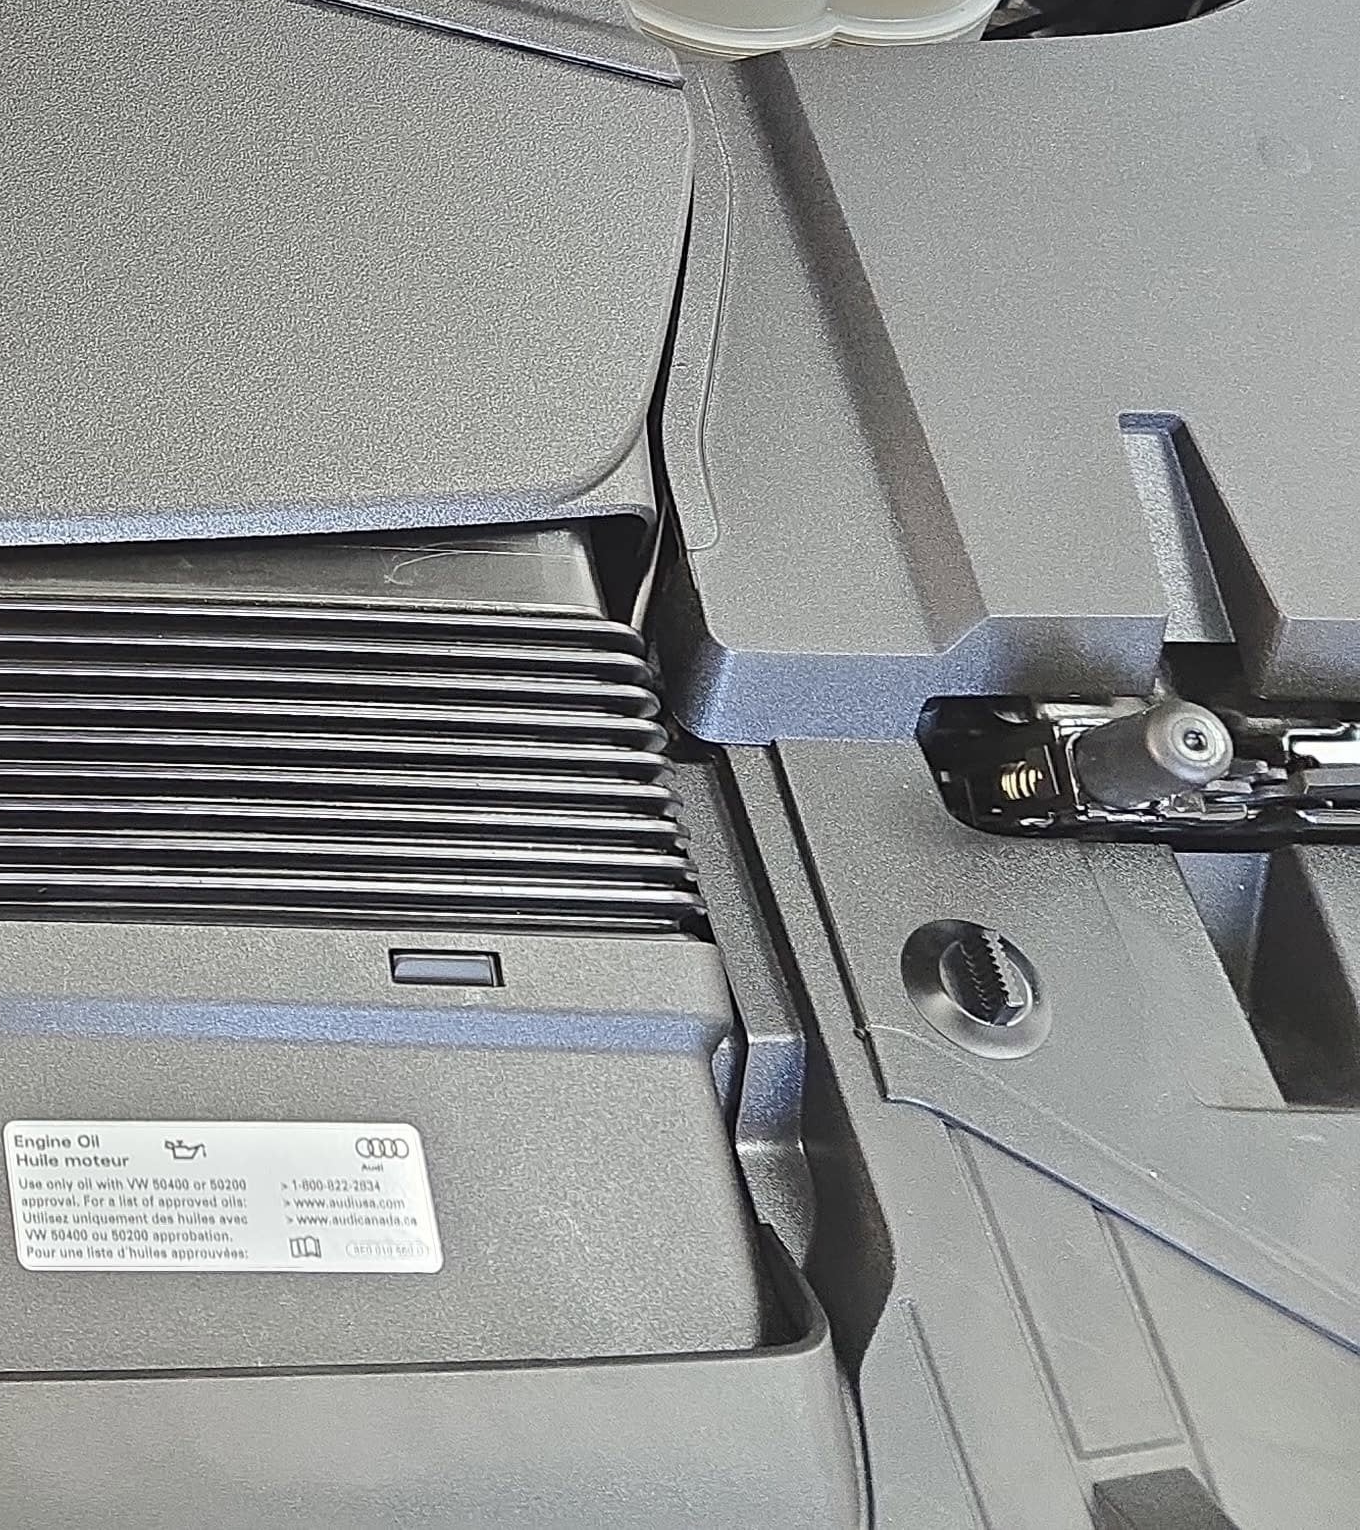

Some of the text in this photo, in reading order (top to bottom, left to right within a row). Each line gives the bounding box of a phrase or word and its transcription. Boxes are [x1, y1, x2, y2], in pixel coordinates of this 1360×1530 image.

[14, 1135, 100, 1150] Engine Oil
[16, 1154, 129, 1168] Huile moteur
[18, 1178, 247, 1192] Use only oil with VW 50400 or 50200
[21, 1195, 247, 1209] approval. For a list of approved oils:
[293, 1197, 405, 1209] www.audiusa.com
[22, 1212, 248, 1226] Utilisez uniquement des huiles avec
[296, 1215, 417, 1227] www.audicanada.ca
[25, 1229, 233, 1243] VW 50400 ou 50200 approbation.
[27, 1246, 248, 1260] Pour une liste d'huiles approuvées:
